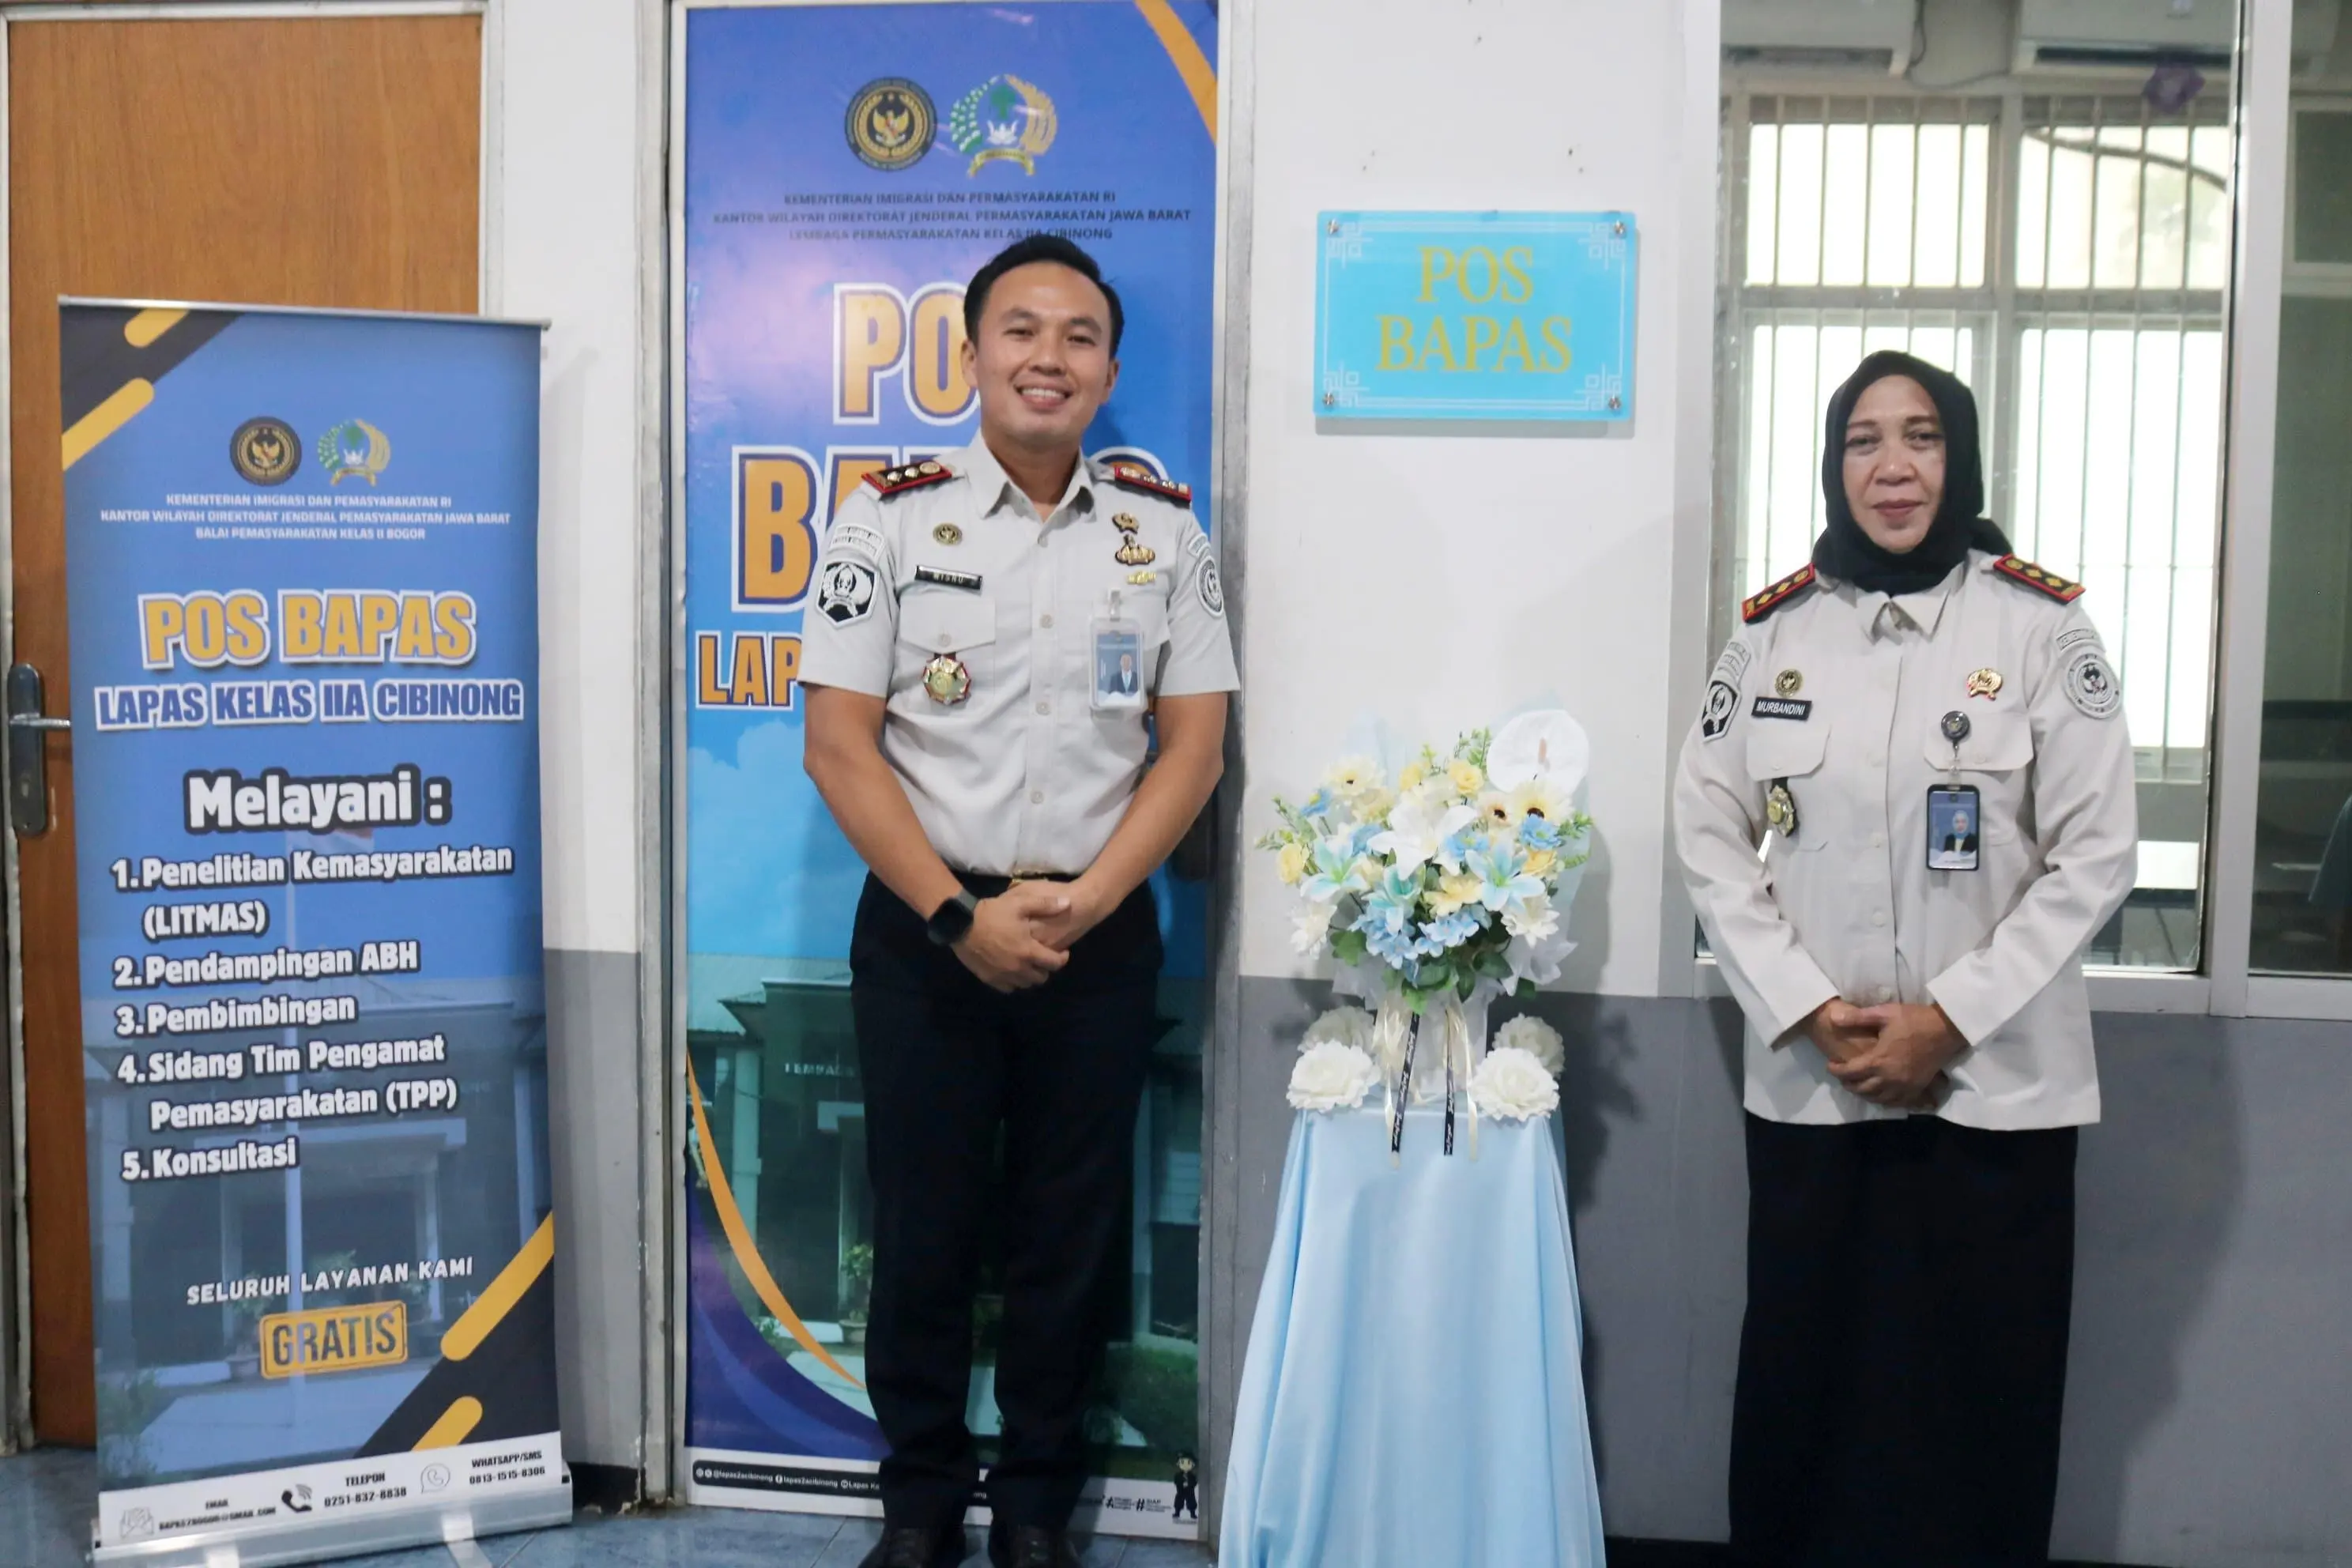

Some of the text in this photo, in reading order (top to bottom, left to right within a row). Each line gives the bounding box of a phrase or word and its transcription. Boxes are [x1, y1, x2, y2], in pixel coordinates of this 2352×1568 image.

[828, 211, 905, 223] DIREKTORAT
[909, 210, 971, 223] JENDERAL
[1109, 209, 1144, 222] JAWA
[1148, 209, 1190, 221] BARAT
[876, 194, 933, 204] IMIGRASI
[937, 194, 965, 203] DAN
[1103, 192, 1115, 202] RI
[1415, 246, 1534, 303] POS
[834, 283, 980, 424] PO
[1375, 314, 1572, 373] BAPAS
[101, 510, 511, 525] KANTOR WILAYAH DIREKTORAT JENDERAL PEMASYARAKATAN JAWA BARAT
[166, 494, 451, 507] KEMENTERIAN IMIGRASI DAN PEMASYARAKATAN RI
[196, 527, 228, 539] BALAI
[232, 527, 337, 540] PEMASYARAKATAN
[340, 528, 374, 540] KELAS
[386, 528, 425, 540] BOGOR
[139, 590, 476, 669] POS BAPAS
[695, 631, 801, 711] LAP
[95, 680, 524, 730] LAPAS KELAS IIA CIBINONG
[187, 770, 413, 827] Melayani
[293, 845, 512, 880] Kemasyarakatan
[143, 901, 266, 938] (LITMAS)
[360, 941, 418, 971] ABH
[251, 1044, 300, 1073] Tim
[309, 1035, 444, 1070] Pengamat
[150, 1078, 458, 1130] Pemasyarakatan (TPP)
[187, 1257, 473, 1305] SELURUH LAYANAN KAMI
[272, 1314, 397, 1366] GRATIS
[472, 1450, 542, 1468] WHATSAPP/SMS
[345, 1472, 386, 1487] TELEPON
